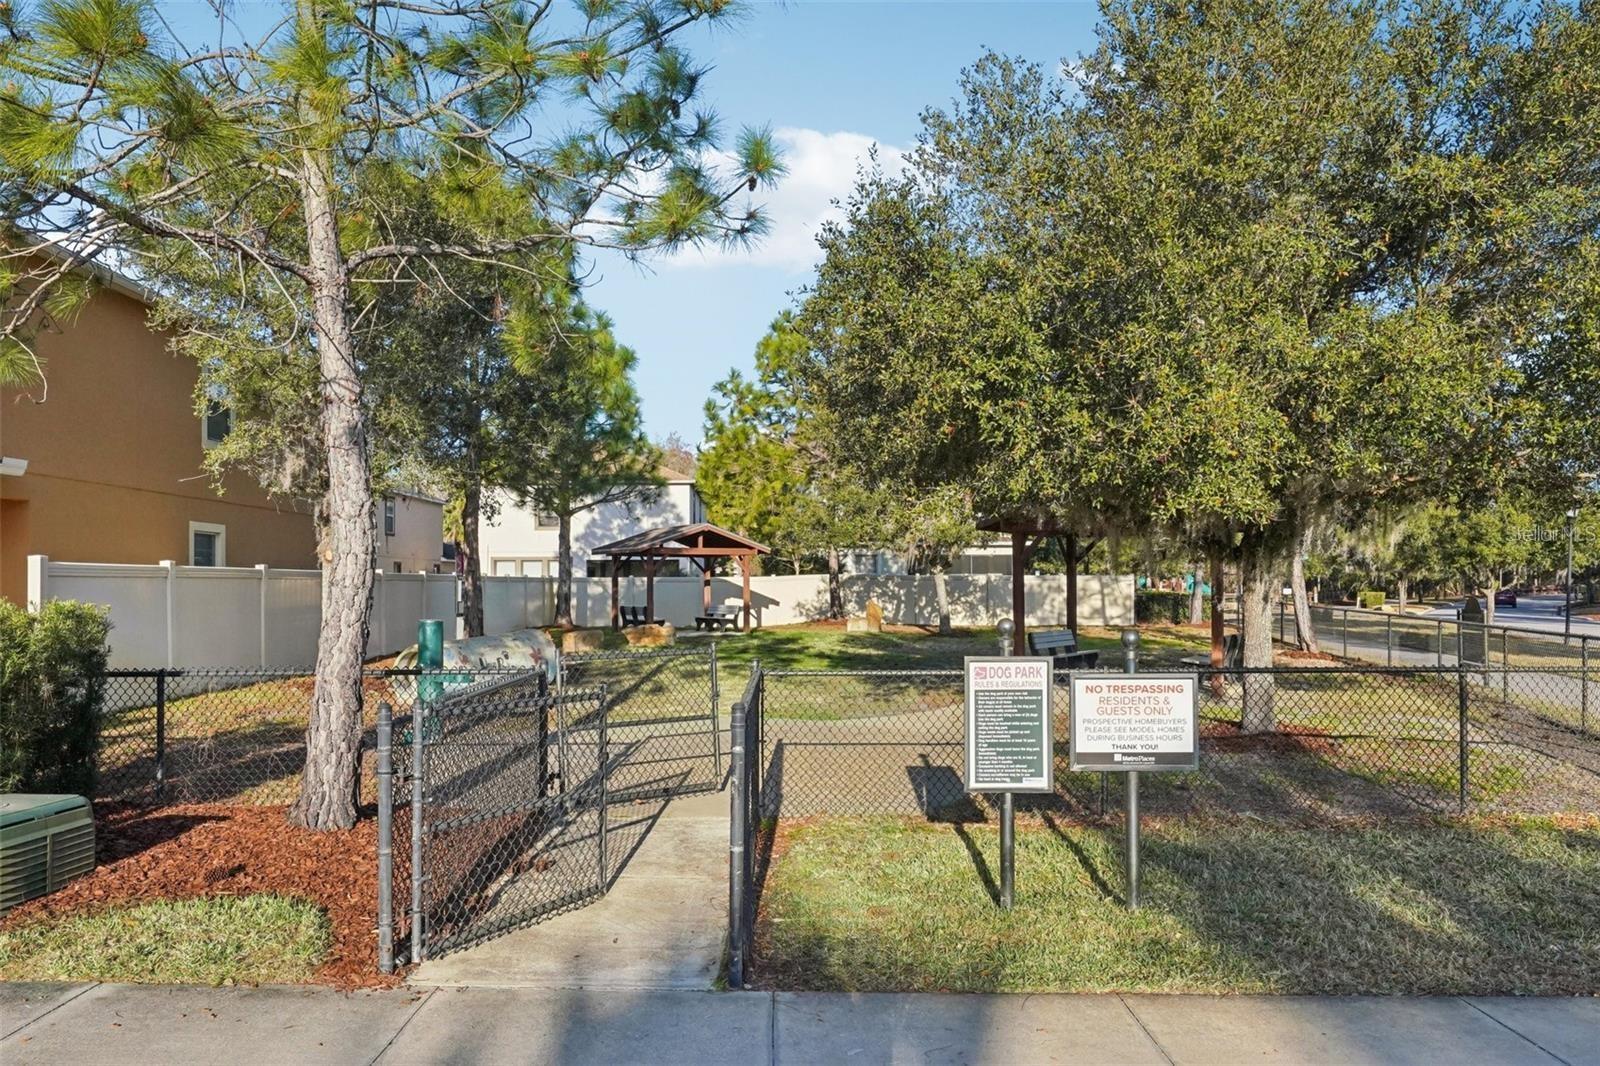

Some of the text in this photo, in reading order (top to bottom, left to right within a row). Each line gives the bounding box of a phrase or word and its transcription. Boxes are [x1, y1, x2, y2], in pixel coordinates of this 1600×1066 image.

[989, 666, 1043, 679] DOG PARK
[1085, 684, 1184, 694] NO TRESPASSING
[1099, 696, 1170, 706] RESIDENTS &
[1096, 706, 1174, 716] GUESTS ONLY
